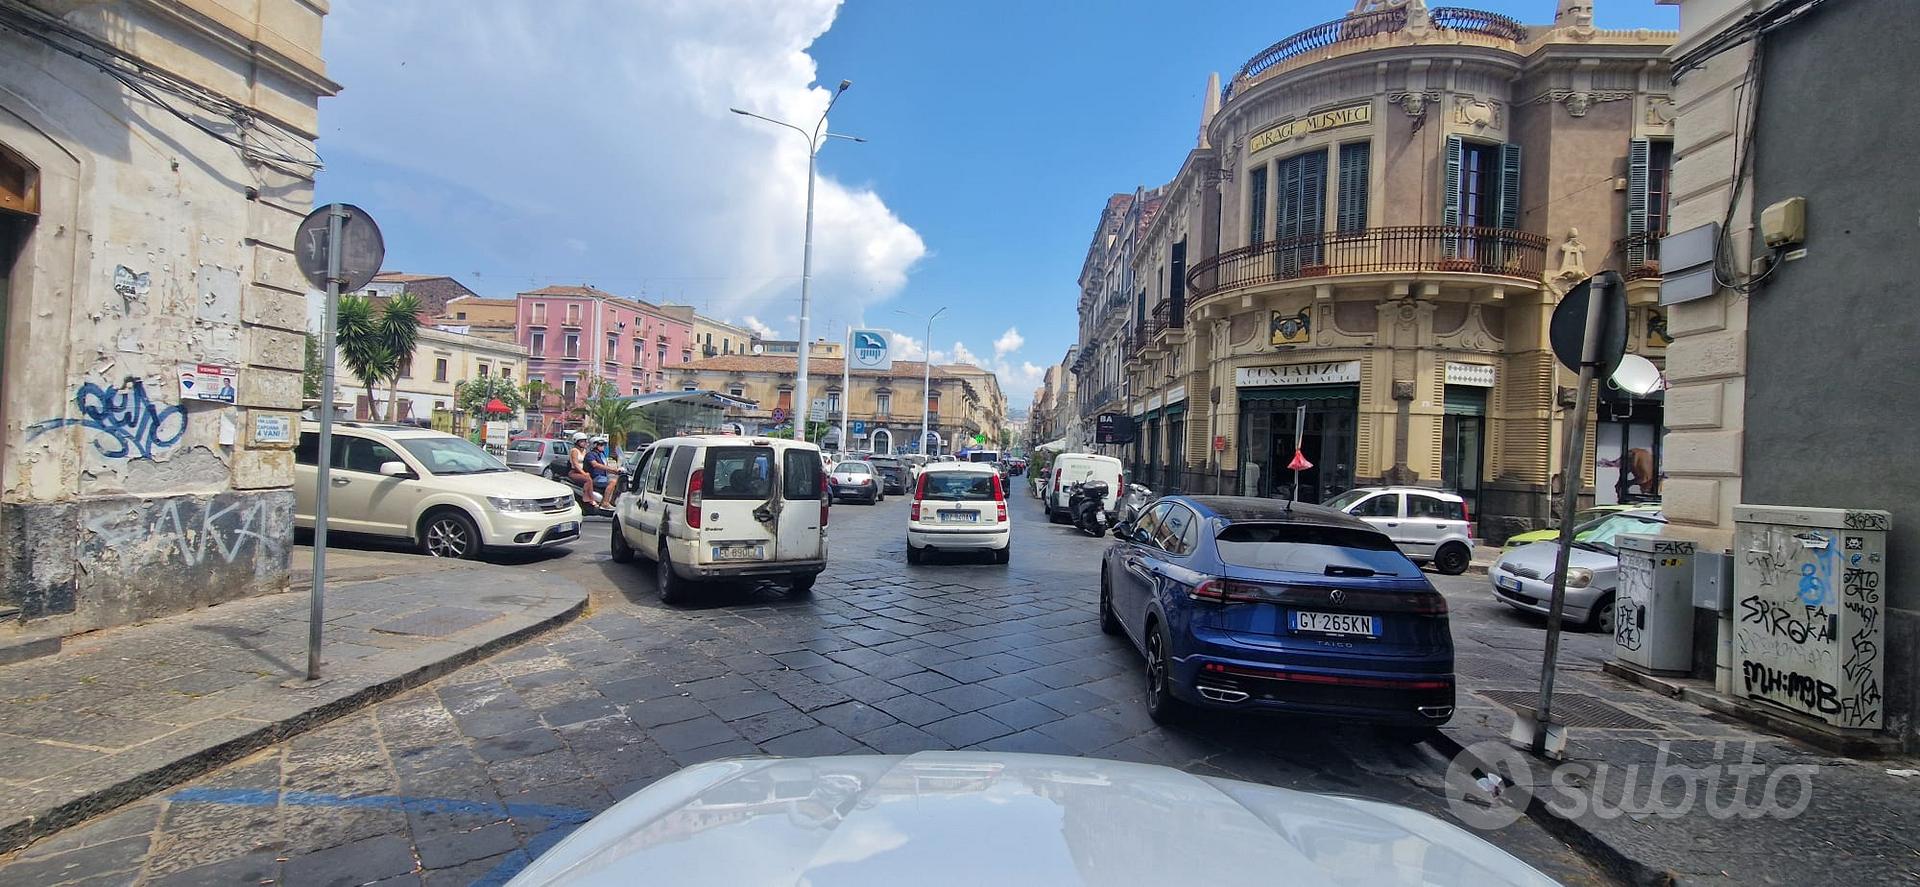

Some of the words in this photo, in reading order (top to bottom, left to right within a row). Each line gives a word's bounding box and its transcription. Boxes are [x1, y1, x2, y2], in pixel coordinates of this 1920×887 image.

[1251, 123, 1296, 151] GARAGE
[1307, 106, 1369, 129] MUSMECI
[1247, 363, 1347, 377] COSTANZO
[1300, 612, 1318, 629] GY
[1323, 614, 1370, 633] 265KN
[1317, 640, 1353, 648] TAIGO
